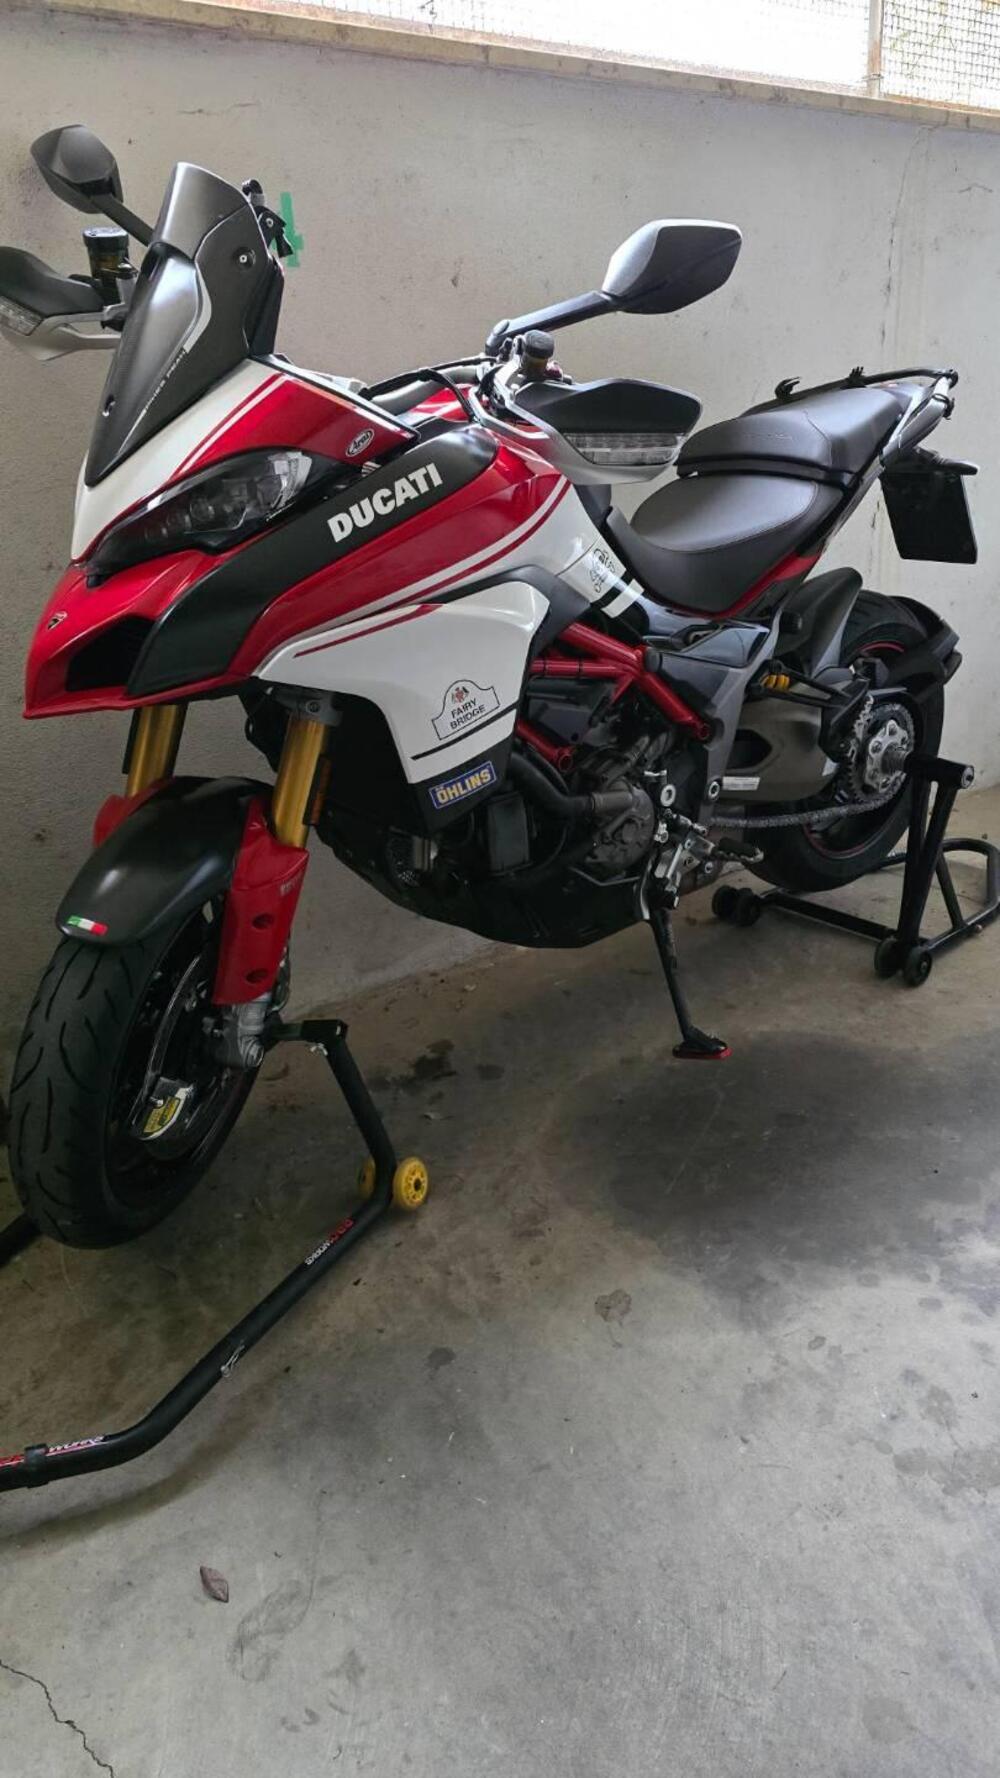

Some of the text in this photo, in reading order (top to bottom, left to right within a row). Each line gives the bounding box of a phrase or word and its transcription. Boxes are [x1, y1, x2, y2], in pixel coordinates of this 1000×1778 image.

[327, 462, 443, 543] DUCATI
[449, 704, 486, 730] BRIDGE
[451, 698, 478, 718] FAIRY
[435, 768, 492, 805] ÖHLINS
